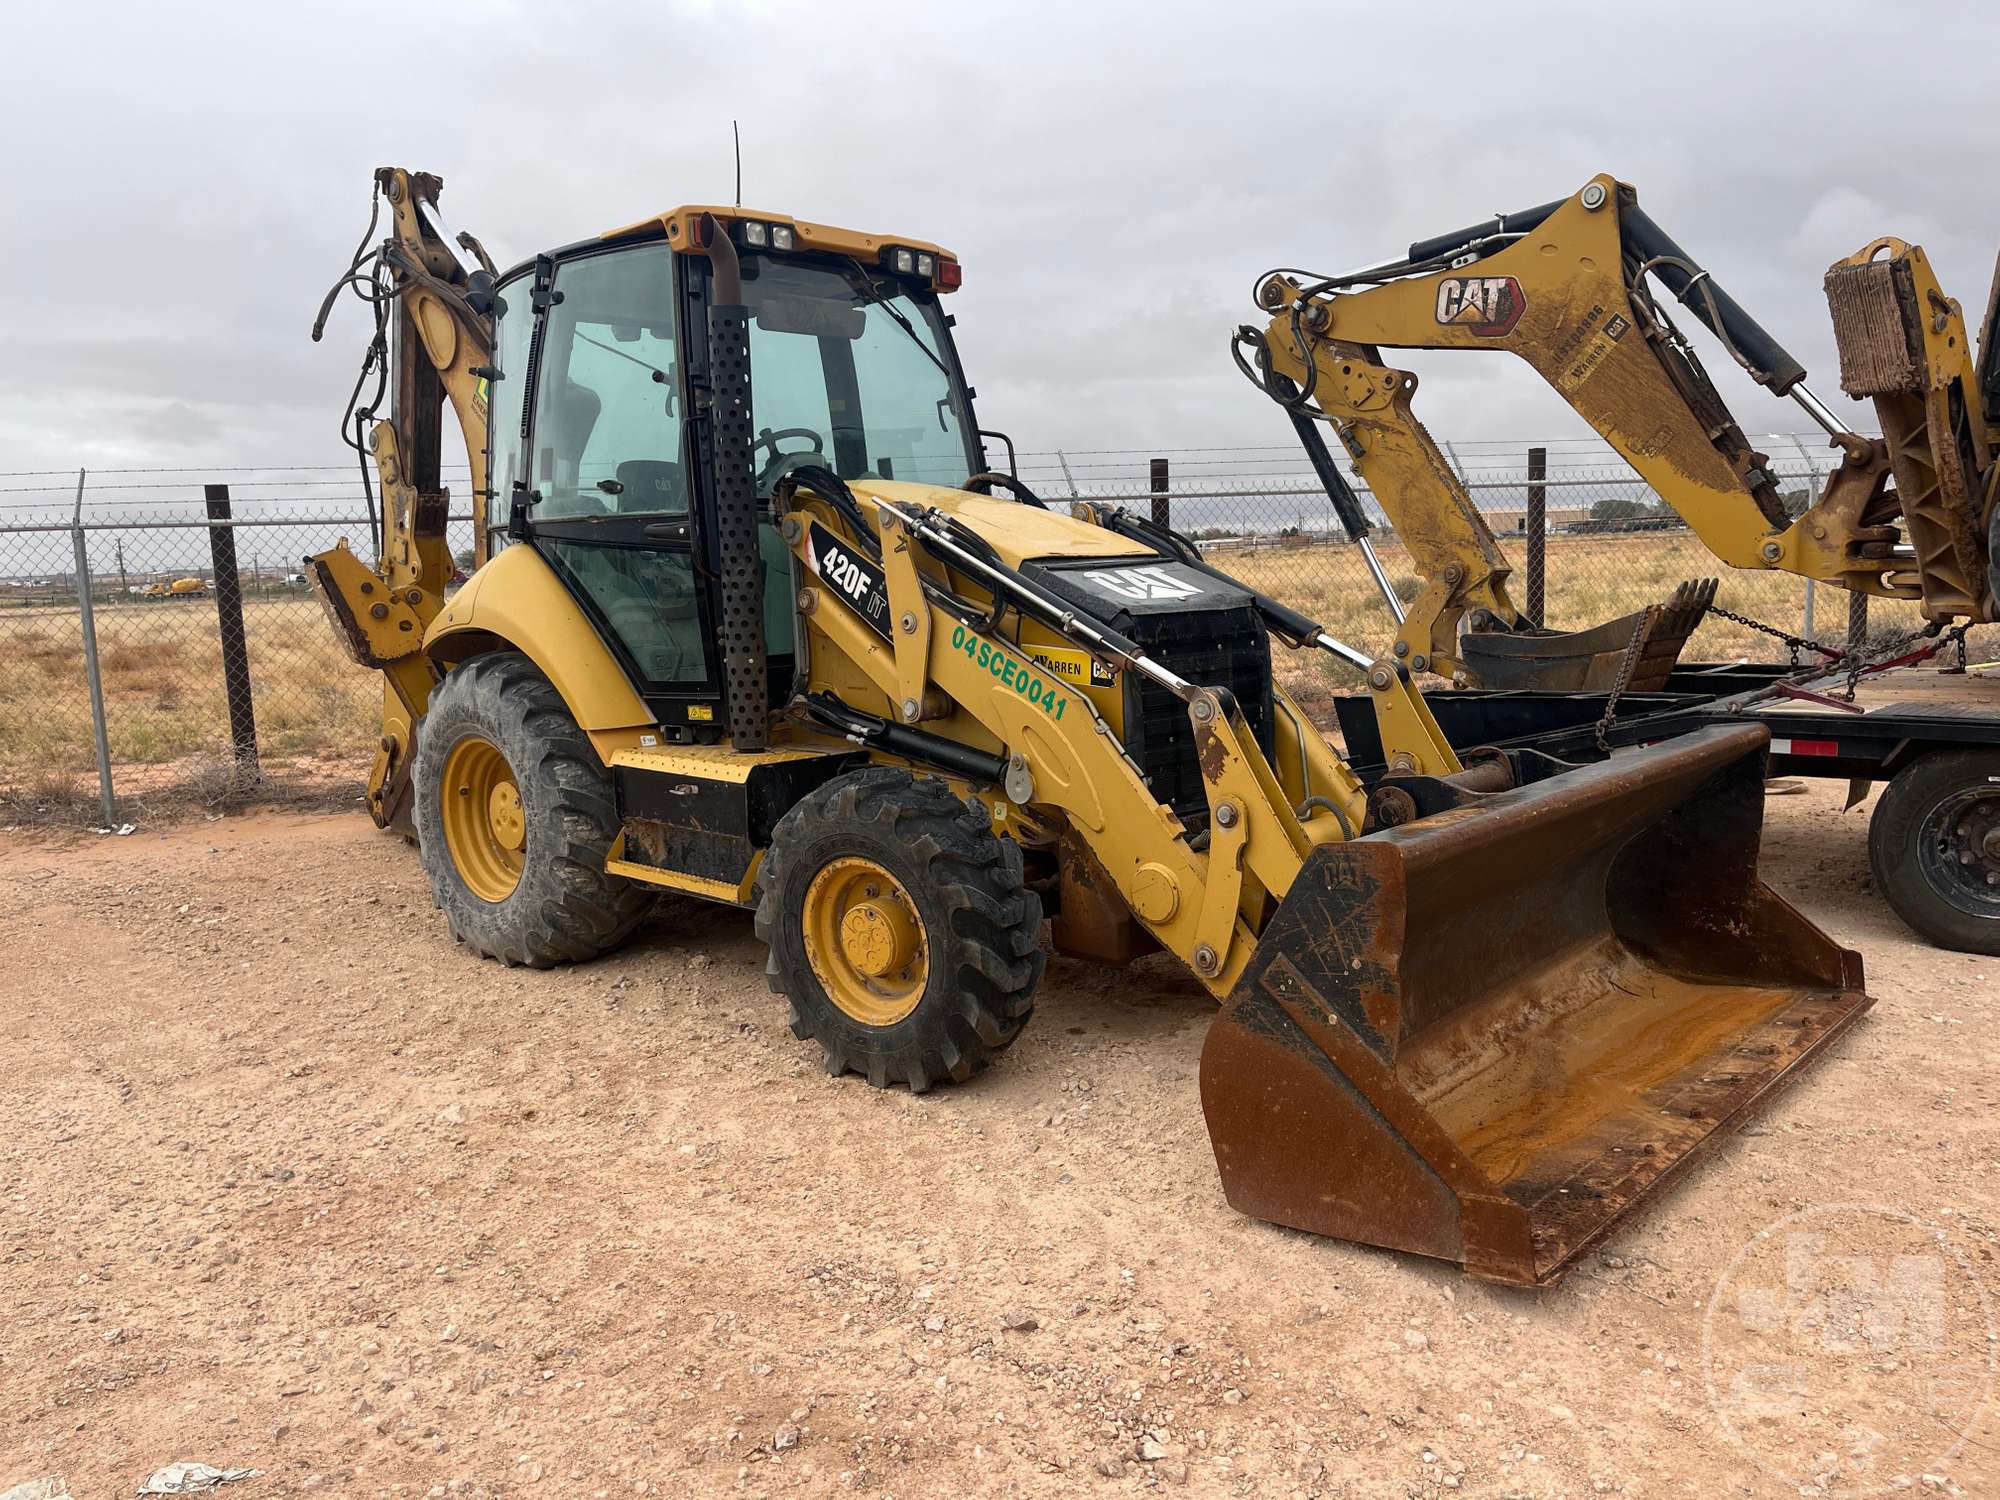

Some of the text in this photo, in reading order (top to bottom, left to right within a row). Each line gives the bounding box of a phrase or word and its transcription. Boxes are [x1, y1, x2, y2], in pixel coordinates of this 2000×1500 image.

[1437, 279, 1506, 323] CAT
[1571, 317, 1626, 378] WARREN CAT
[823, 536, 888, 620] 420F IT
[1083, 566, 1205, 600] CAT
[951, 625, 1067, 721] 04SCE0041
[1031, 654, 1081, 676] WARREN
